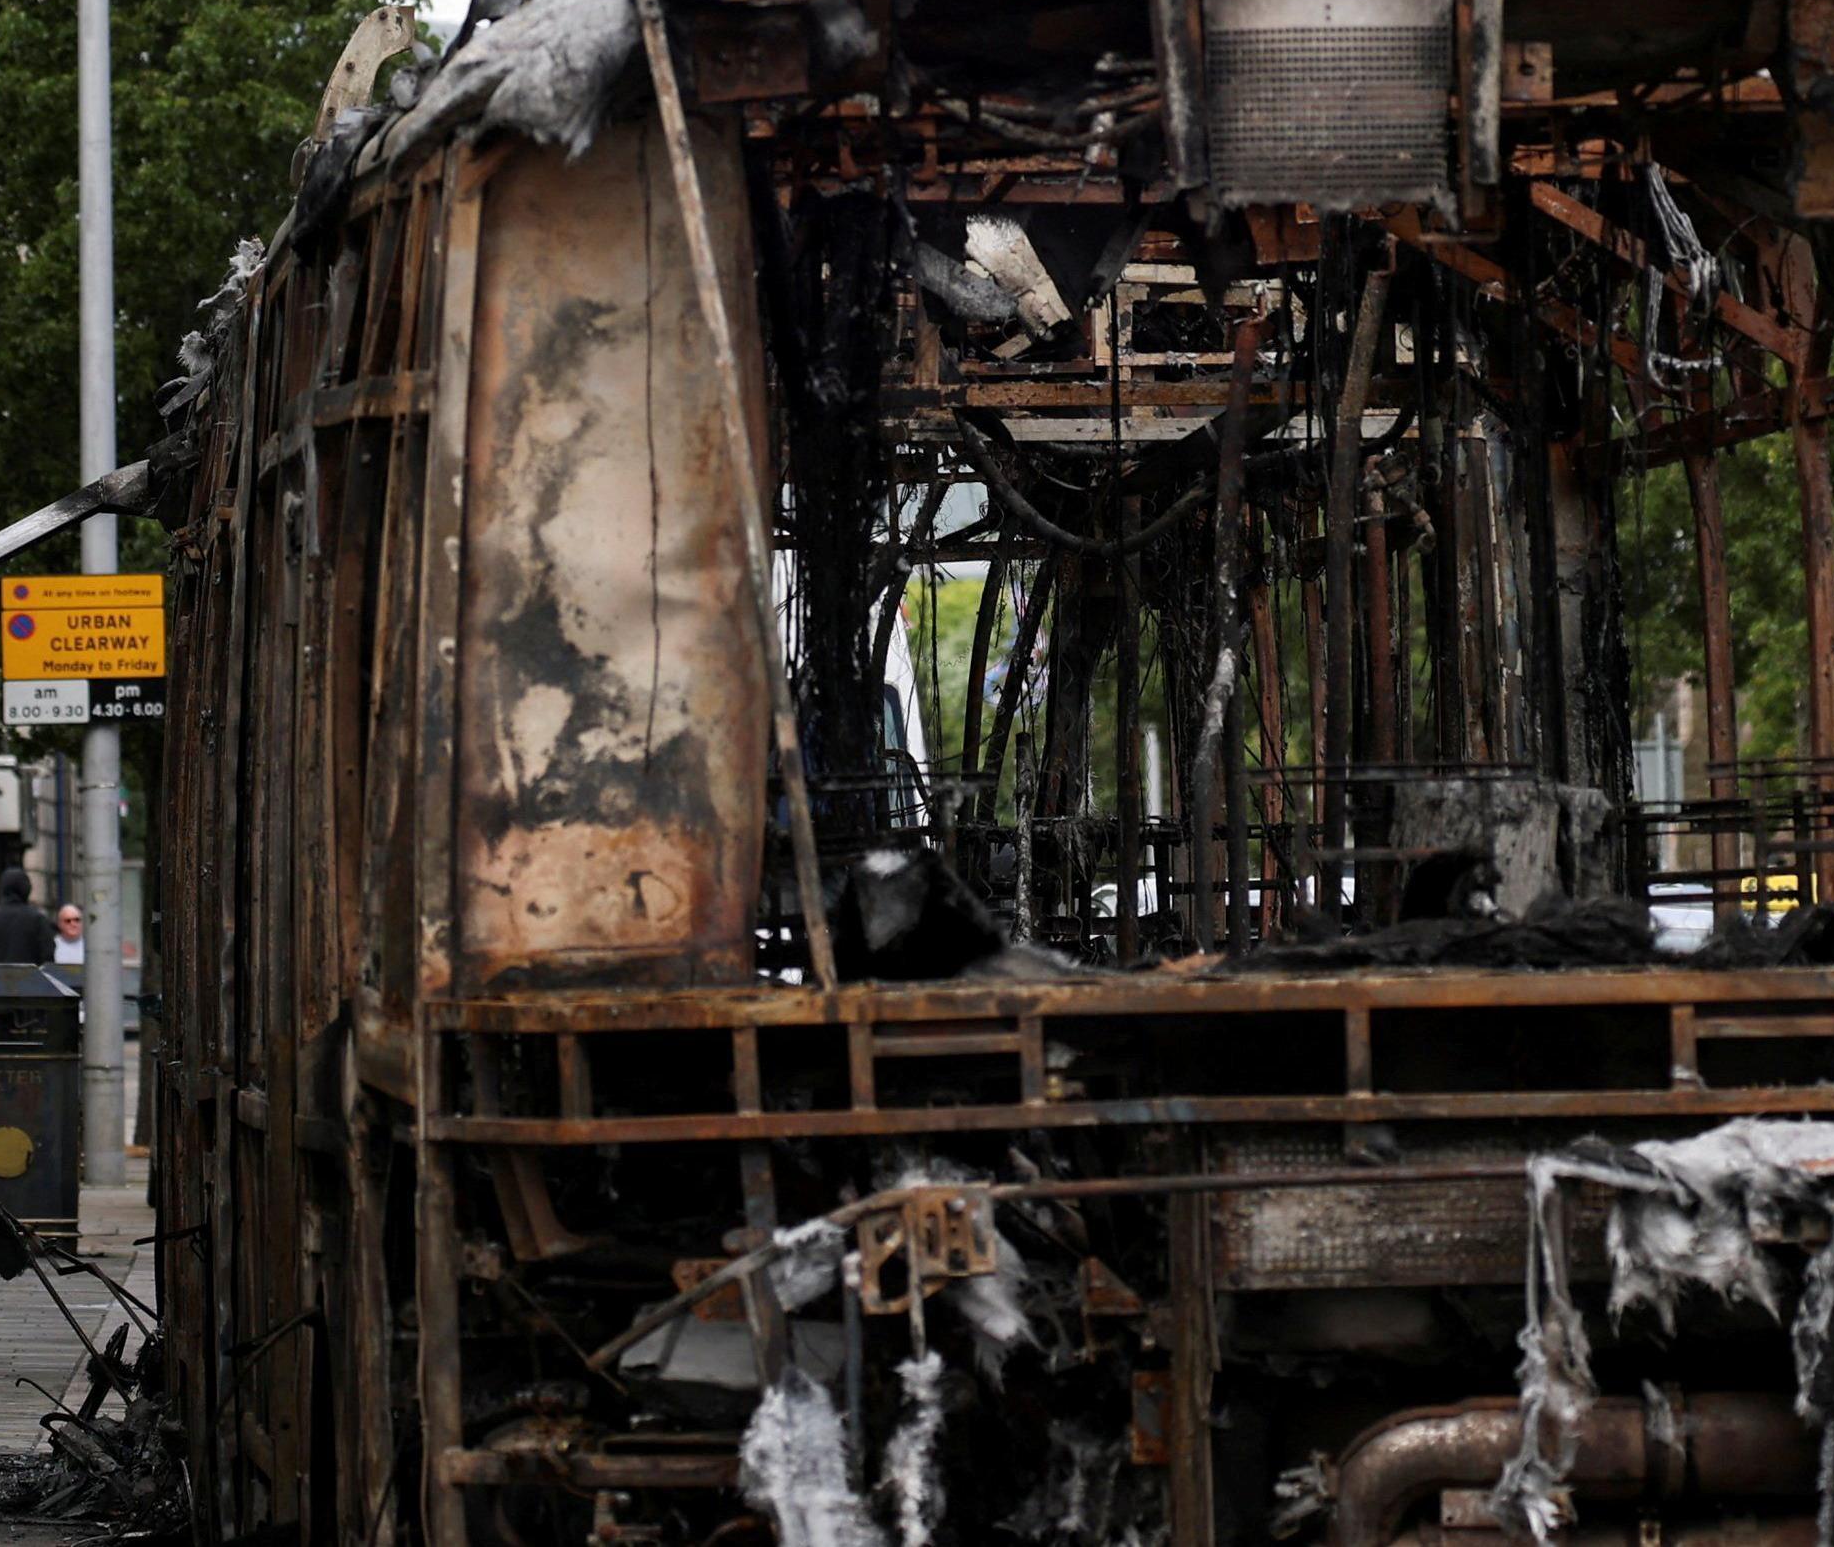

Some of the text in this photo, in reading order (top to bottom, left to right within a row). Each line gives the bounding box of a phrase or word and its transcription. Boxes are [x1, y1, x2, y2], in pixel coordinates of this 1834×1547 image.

[67, 615, 131, 630] URBAN
[50, 636, 150, 651] CLEARWAY
[43, 659, 158, 673] Monday to Friday
[34, 688, 57, 699] am
[114, 685, 141, 700] pm
[92, 703, 124, 717] 4.30
[132, 703, 164, 717] 6.00
